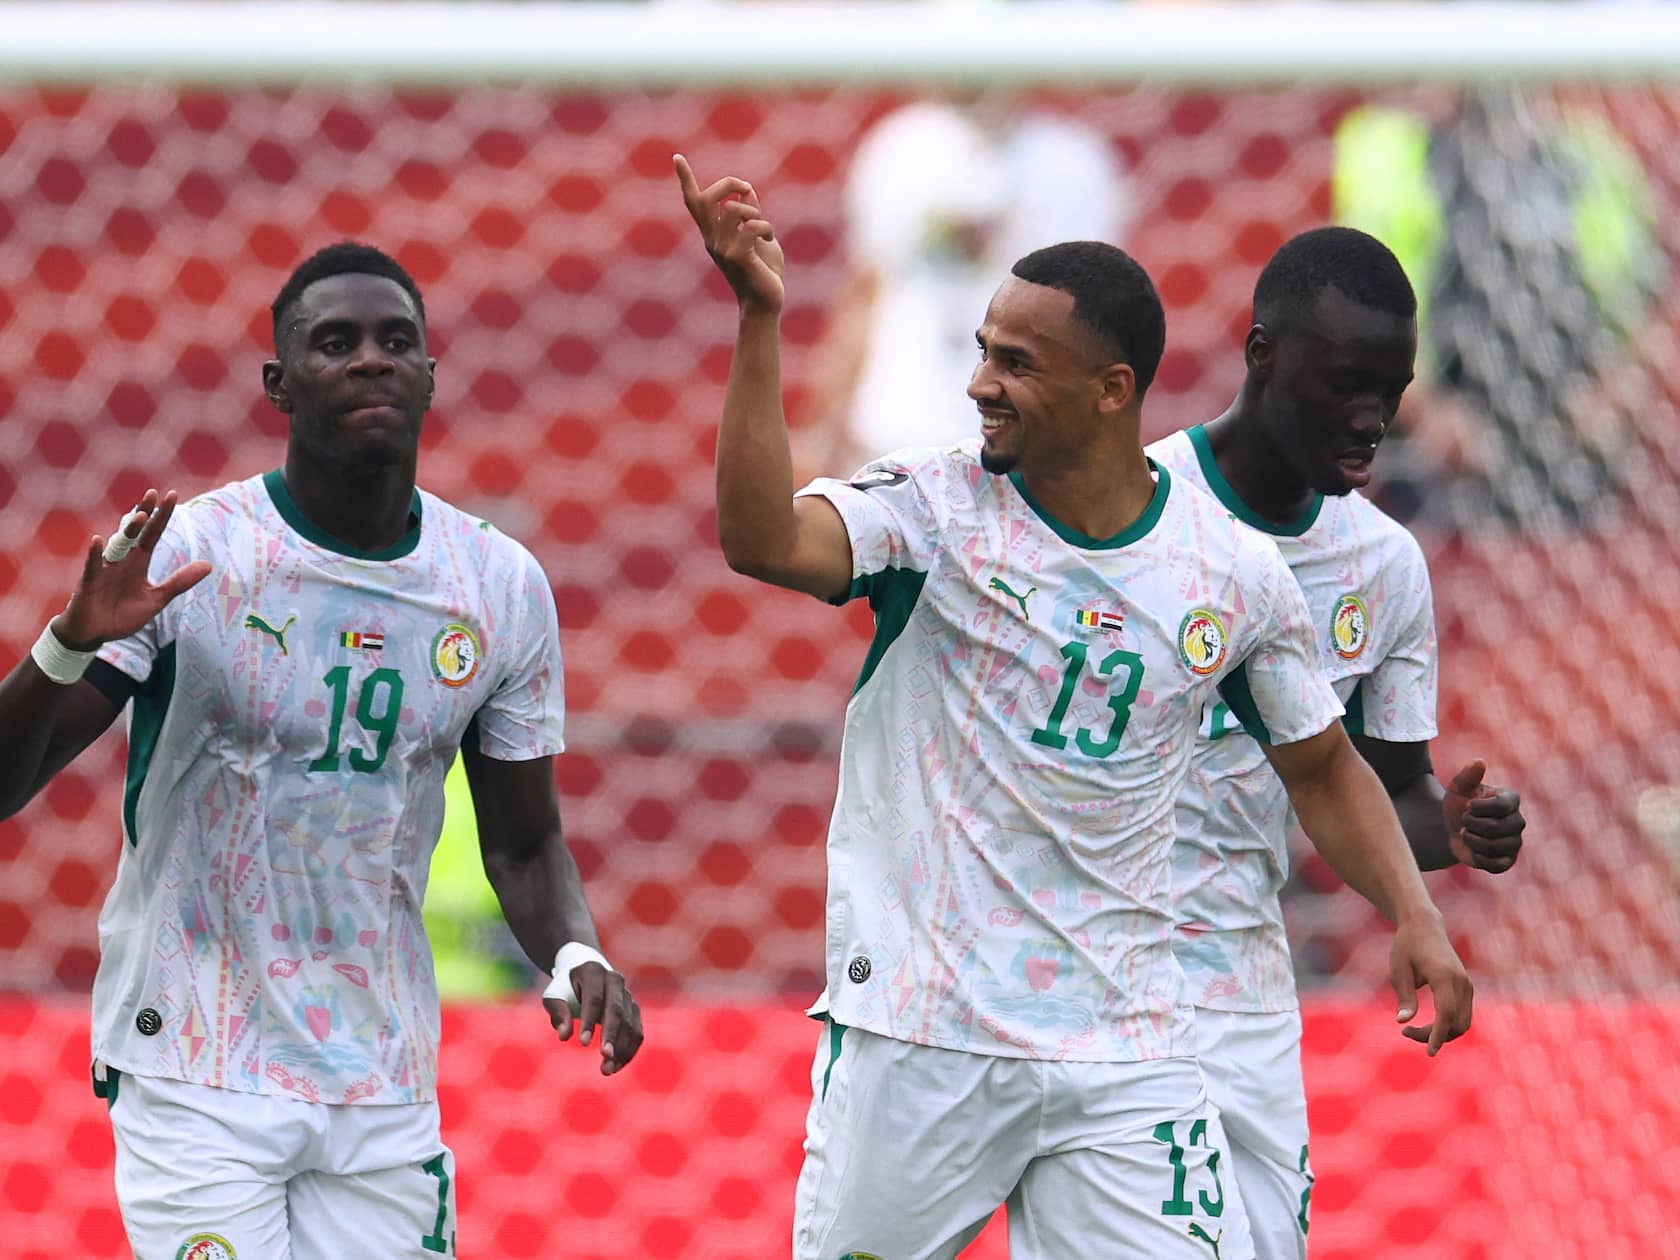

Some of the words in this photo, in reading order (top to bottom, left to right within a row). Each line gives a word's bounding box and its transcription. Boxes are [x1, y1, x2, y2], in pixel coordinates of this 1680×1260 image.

[308, 665, 404, 774] 19
[1030, 640, 1146, 760] 13
[421, 1151, 456, 1258] 1
[1153, 1118, 1224, 1218] 13
